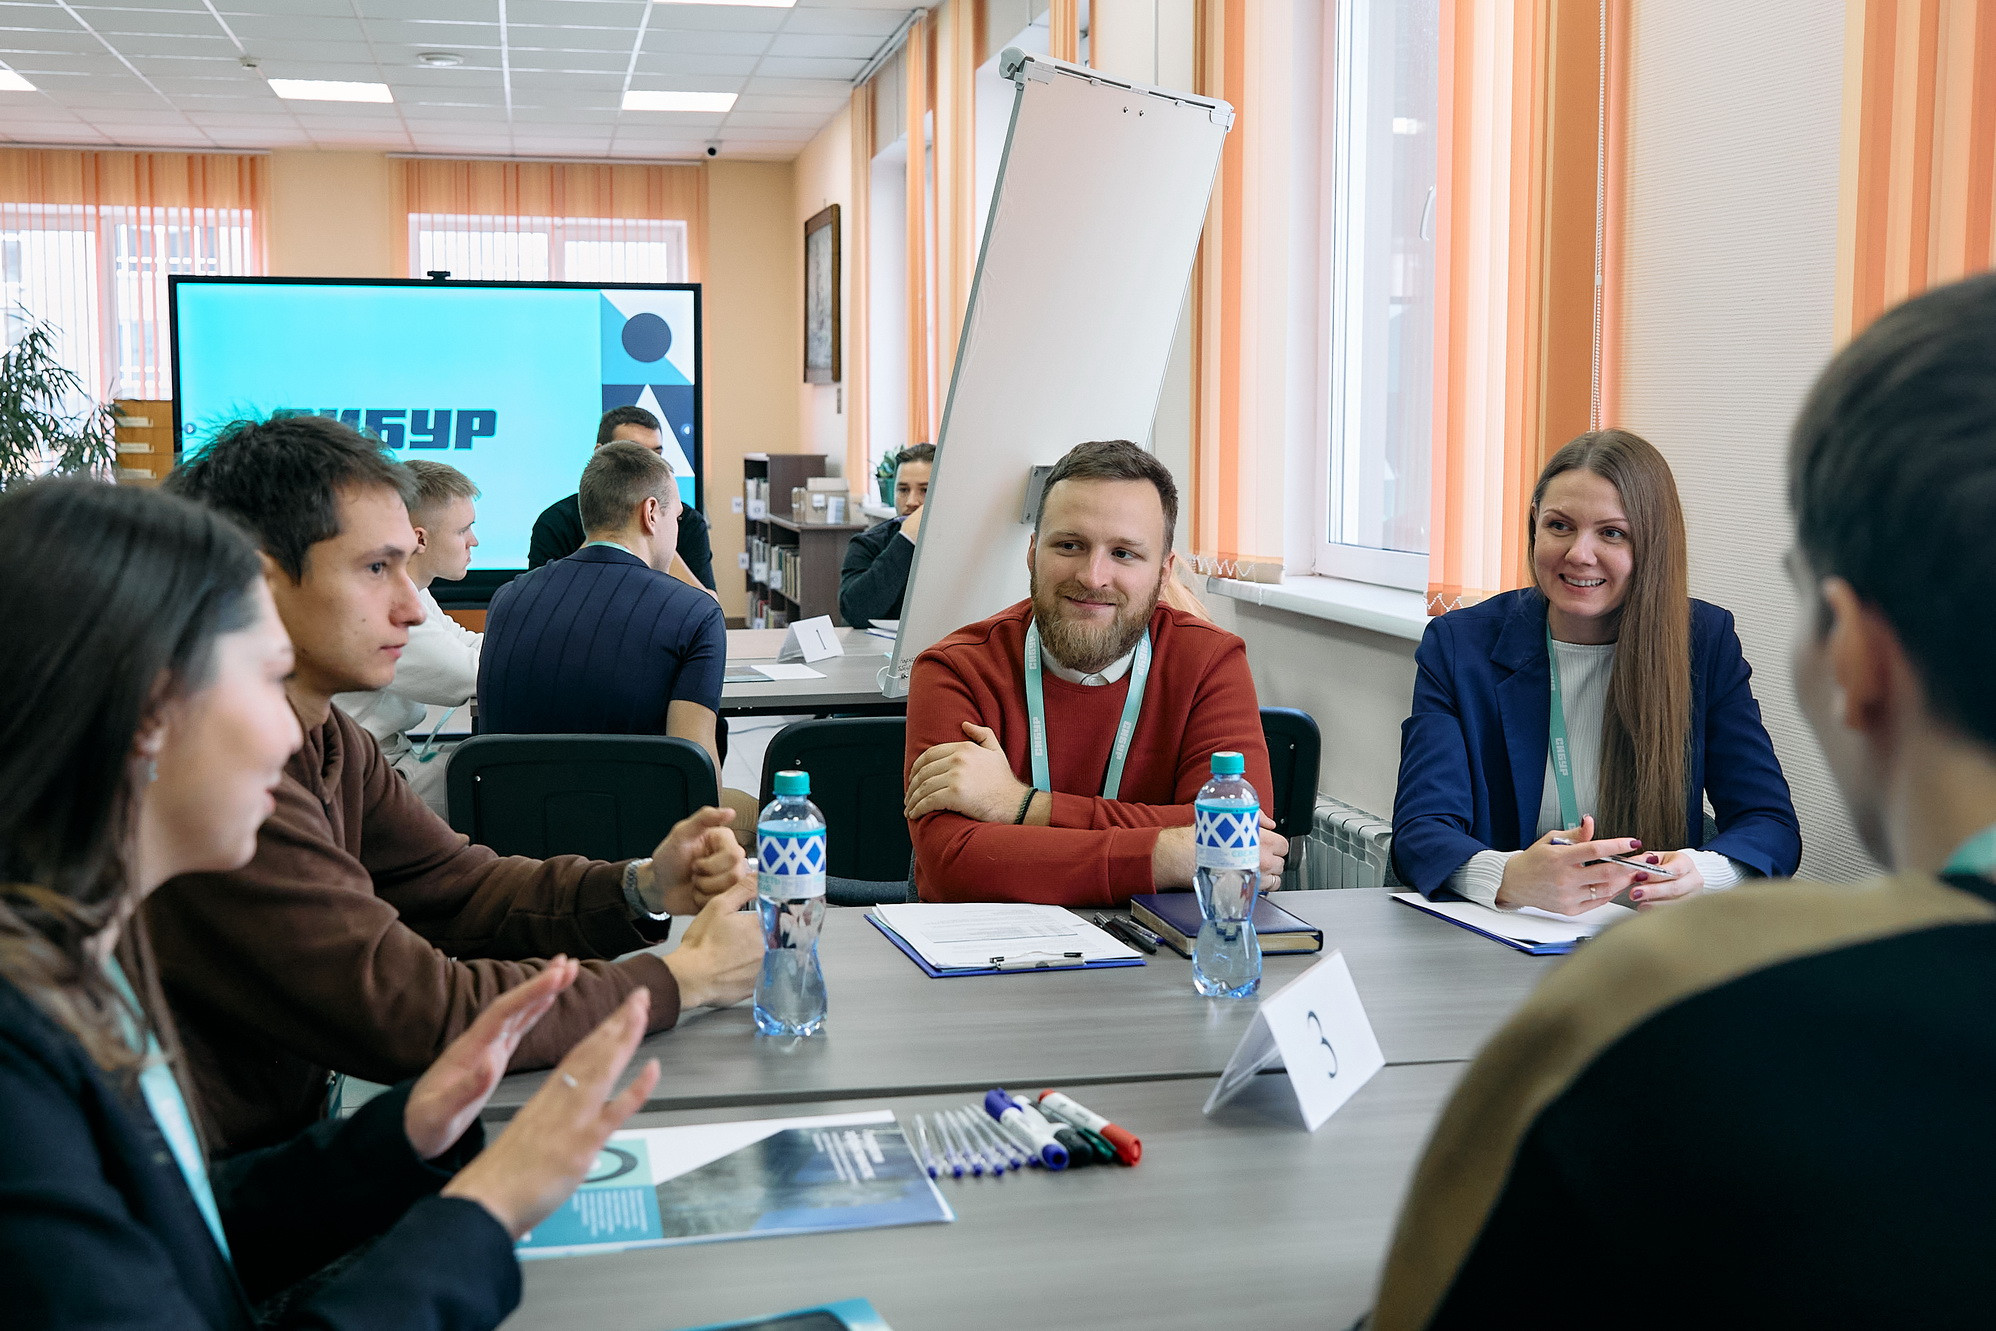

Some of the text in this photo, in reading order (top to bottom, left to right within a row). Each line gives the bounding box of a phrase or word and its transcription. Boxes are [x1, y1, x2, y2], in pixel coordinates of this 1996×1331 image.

[271, 409, 497, 449] БУР
[1032, 716, 1043, 757] СИБУР
[1116, 720, 1132, 760] СИБУР
[1555, 737, 1569, 777] СИБУР
[1308, 1010, 1338, 1079] 3
